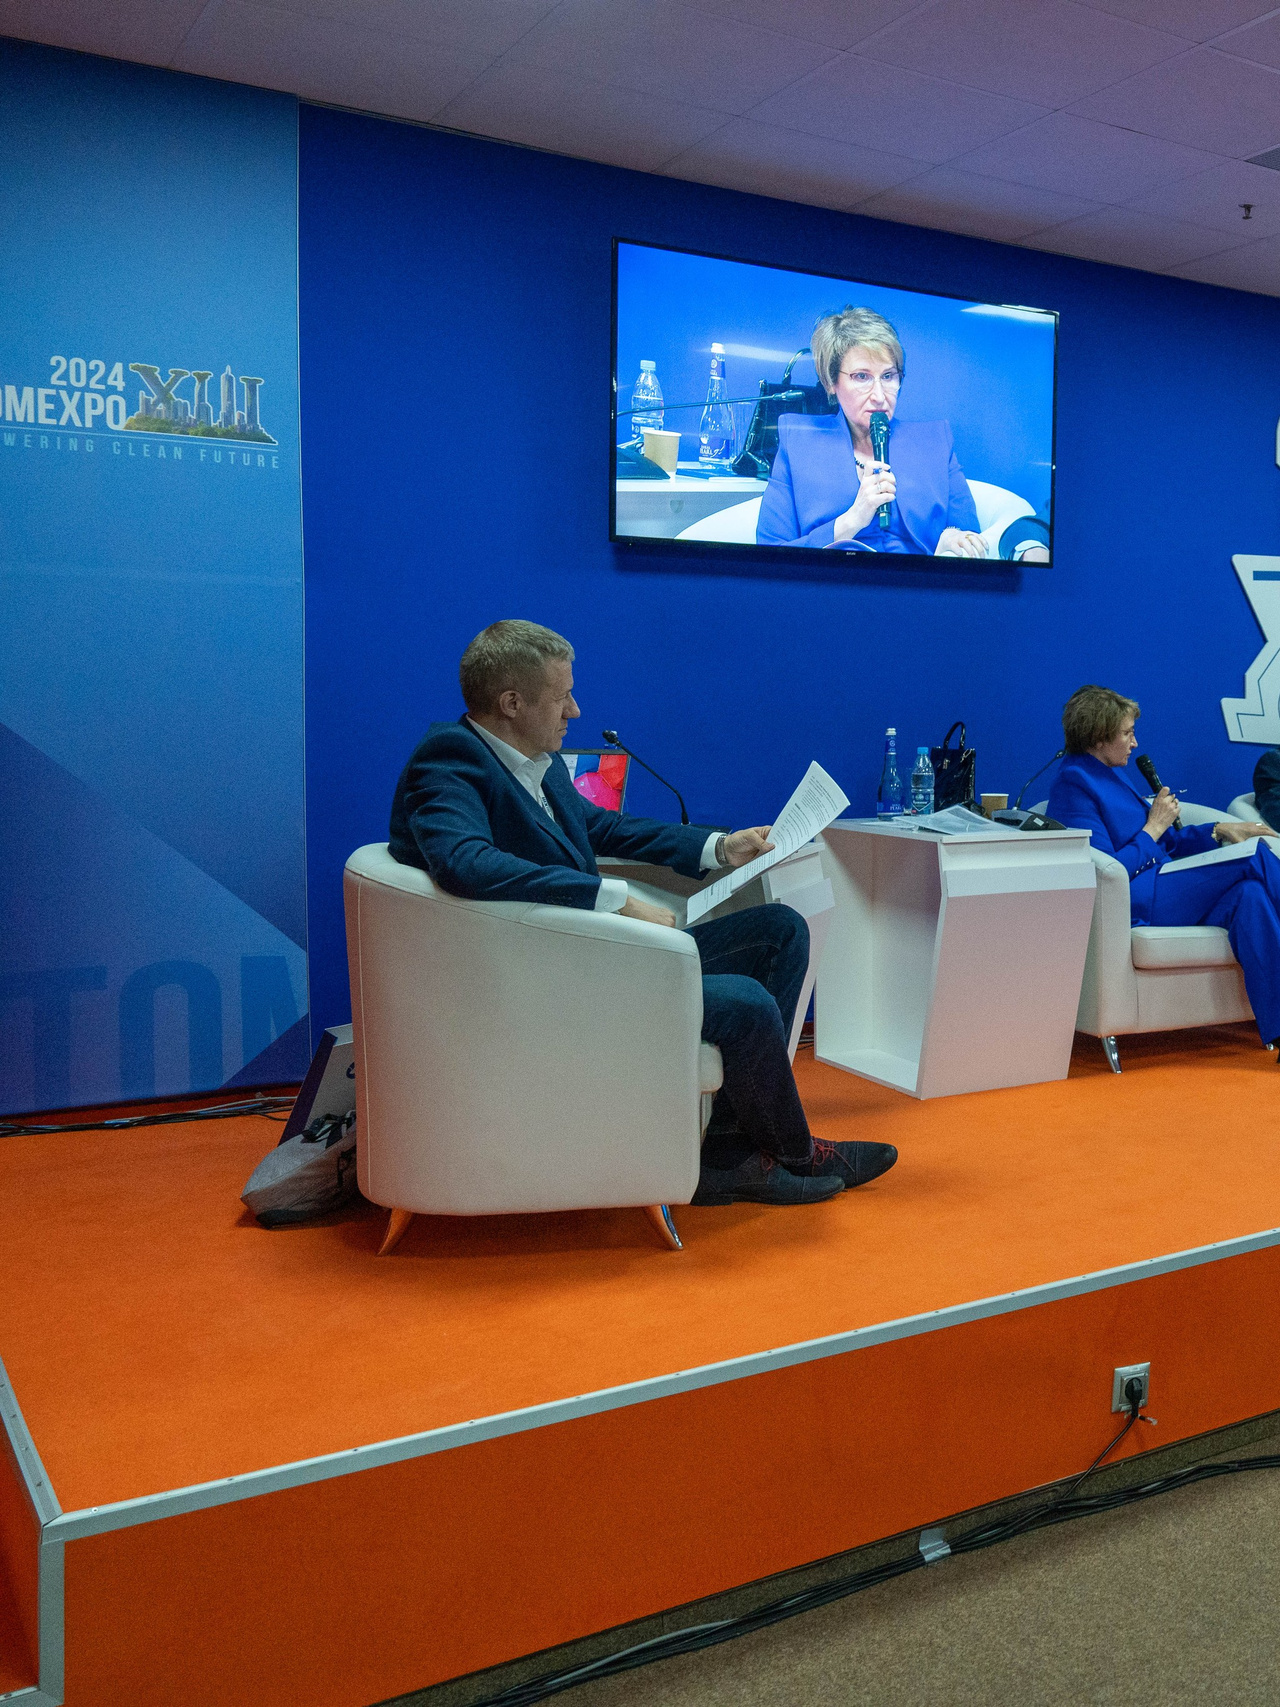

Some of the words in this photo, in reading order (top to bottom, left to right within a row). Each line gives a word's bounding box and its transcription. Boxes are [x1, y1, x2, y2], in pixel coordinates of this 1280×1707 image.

[50, 355, 126, 392] 2024
[0, 383, 127, 431] MEXPO
[112, 440, 183, 460] CLEAN
[199, 448, 280, 469] FUTURE
